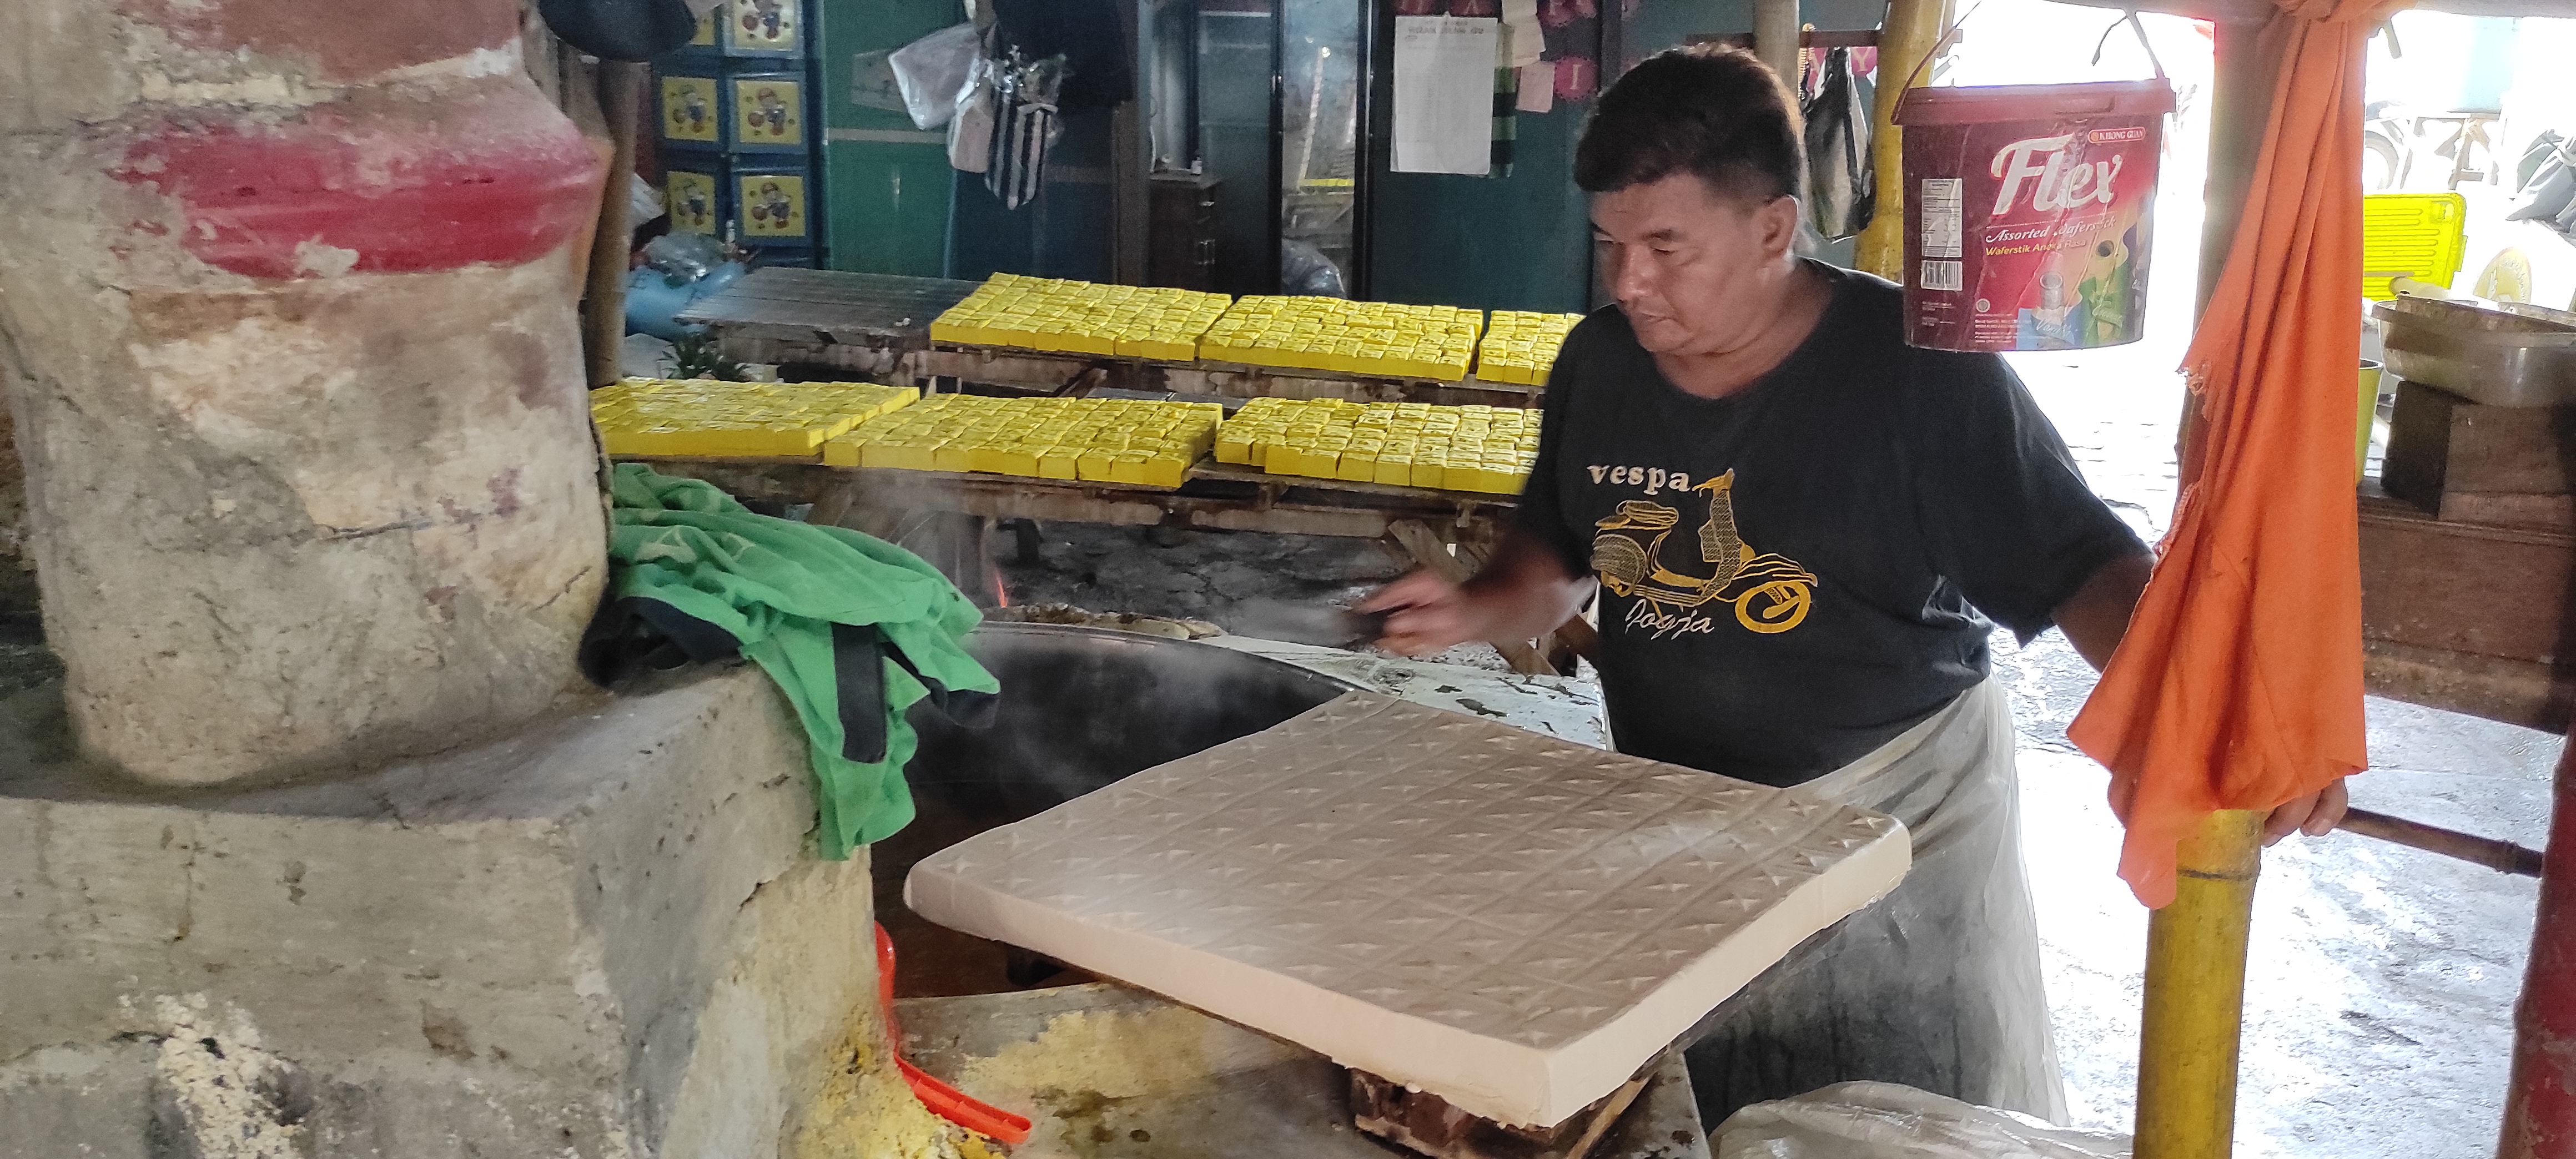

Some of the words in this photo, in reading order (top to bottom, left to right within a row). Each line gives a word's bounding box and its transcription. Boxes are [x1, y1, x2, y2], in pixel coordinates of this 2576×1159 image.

[2099, 131, 2126, 140] KHONG
[1990, 132, 2122, 215] Flex
[1985, 225, 2051, 243] Assorted
[1985, 245, 2031, 256] Waferstik
[1586, 465, 1691, 496] vespa
